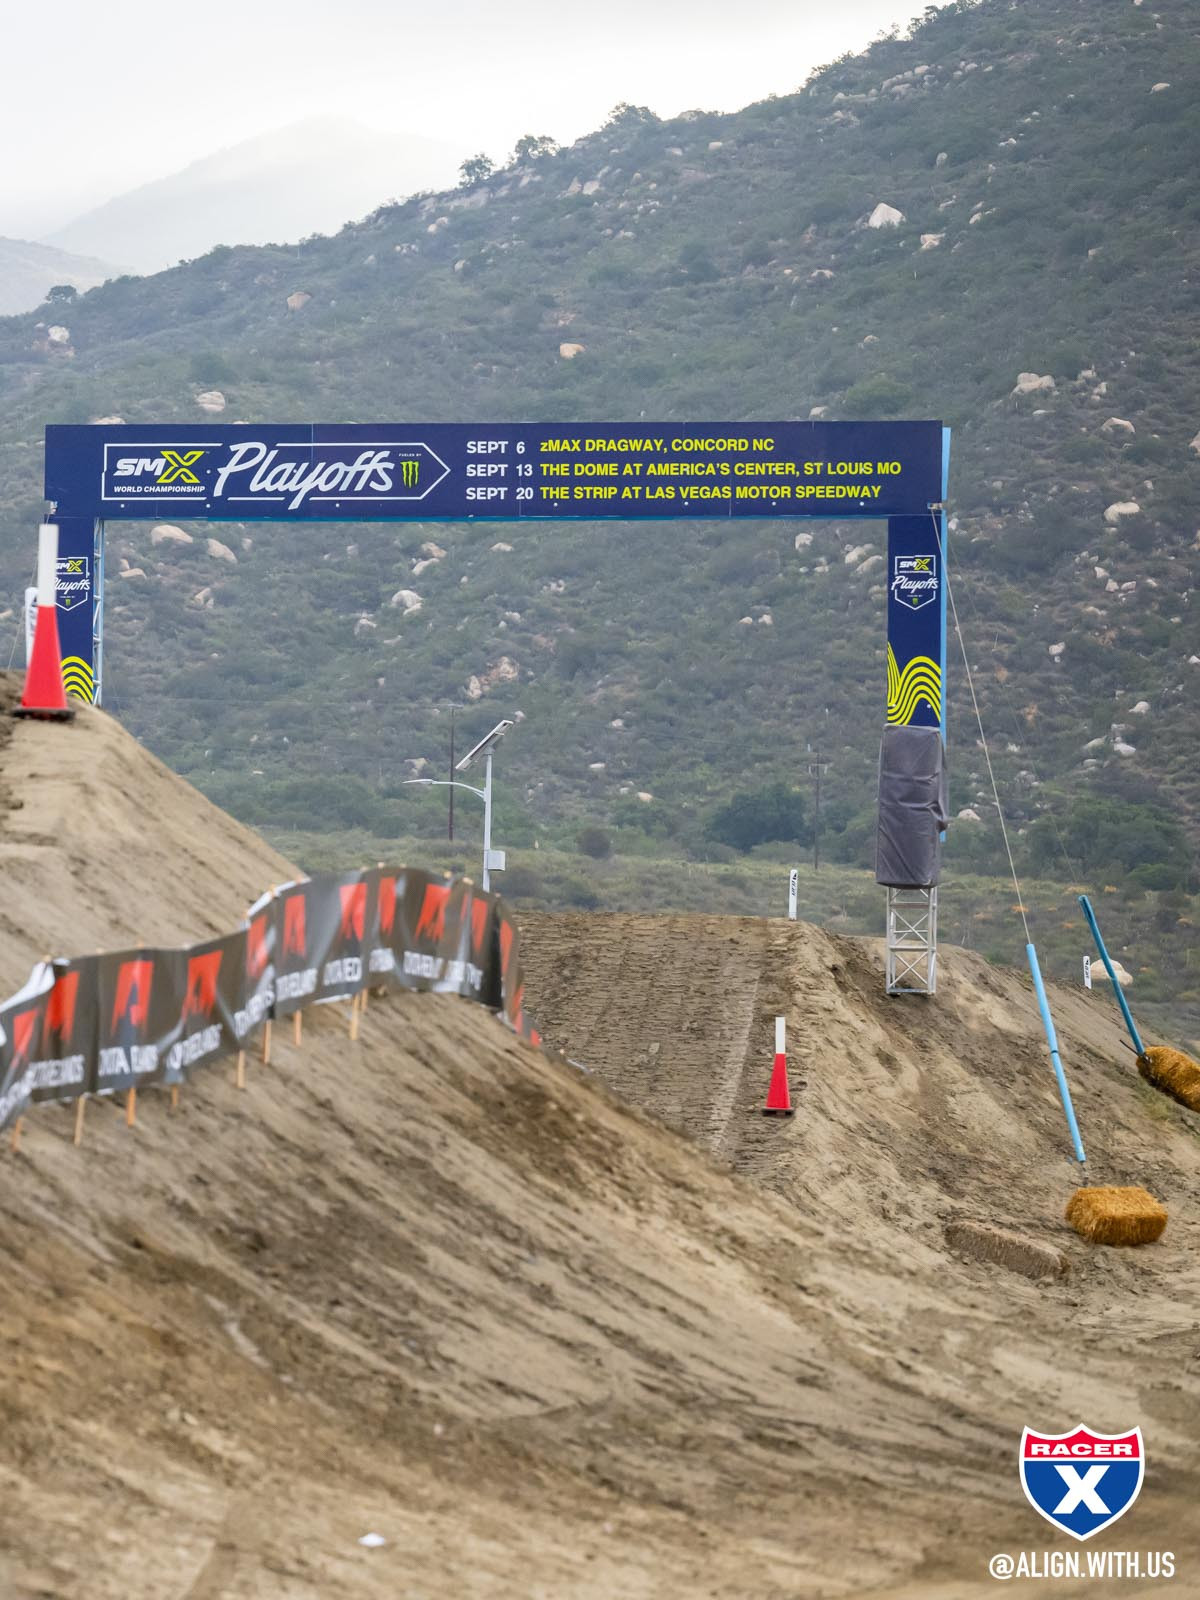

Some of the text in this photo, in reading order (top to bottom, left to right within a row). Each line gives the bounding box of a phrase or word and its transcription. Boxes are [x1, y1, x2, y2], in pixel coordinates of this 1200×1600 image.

[466, 438, 775, 454] SEPT 6 zMAX DRAGWAY, CONCORD NC
[113, 451, 205, 483] SMX
[466, 462, 901, 477] SEPT 13 THE DOME AT AMERICA'S CENTER, ST LOUIS MO
[213, 442, 395, 510] Playoffs
[466, 485, 881, 500] SEPT 20 THE STRIP AT LAS VEGAS MOTOR SPEEDWAY
[899, 558, 930, 570] SMX
[55, 577, 91, 595] layoffs
[891, 576, 939, 594] Playoffs
